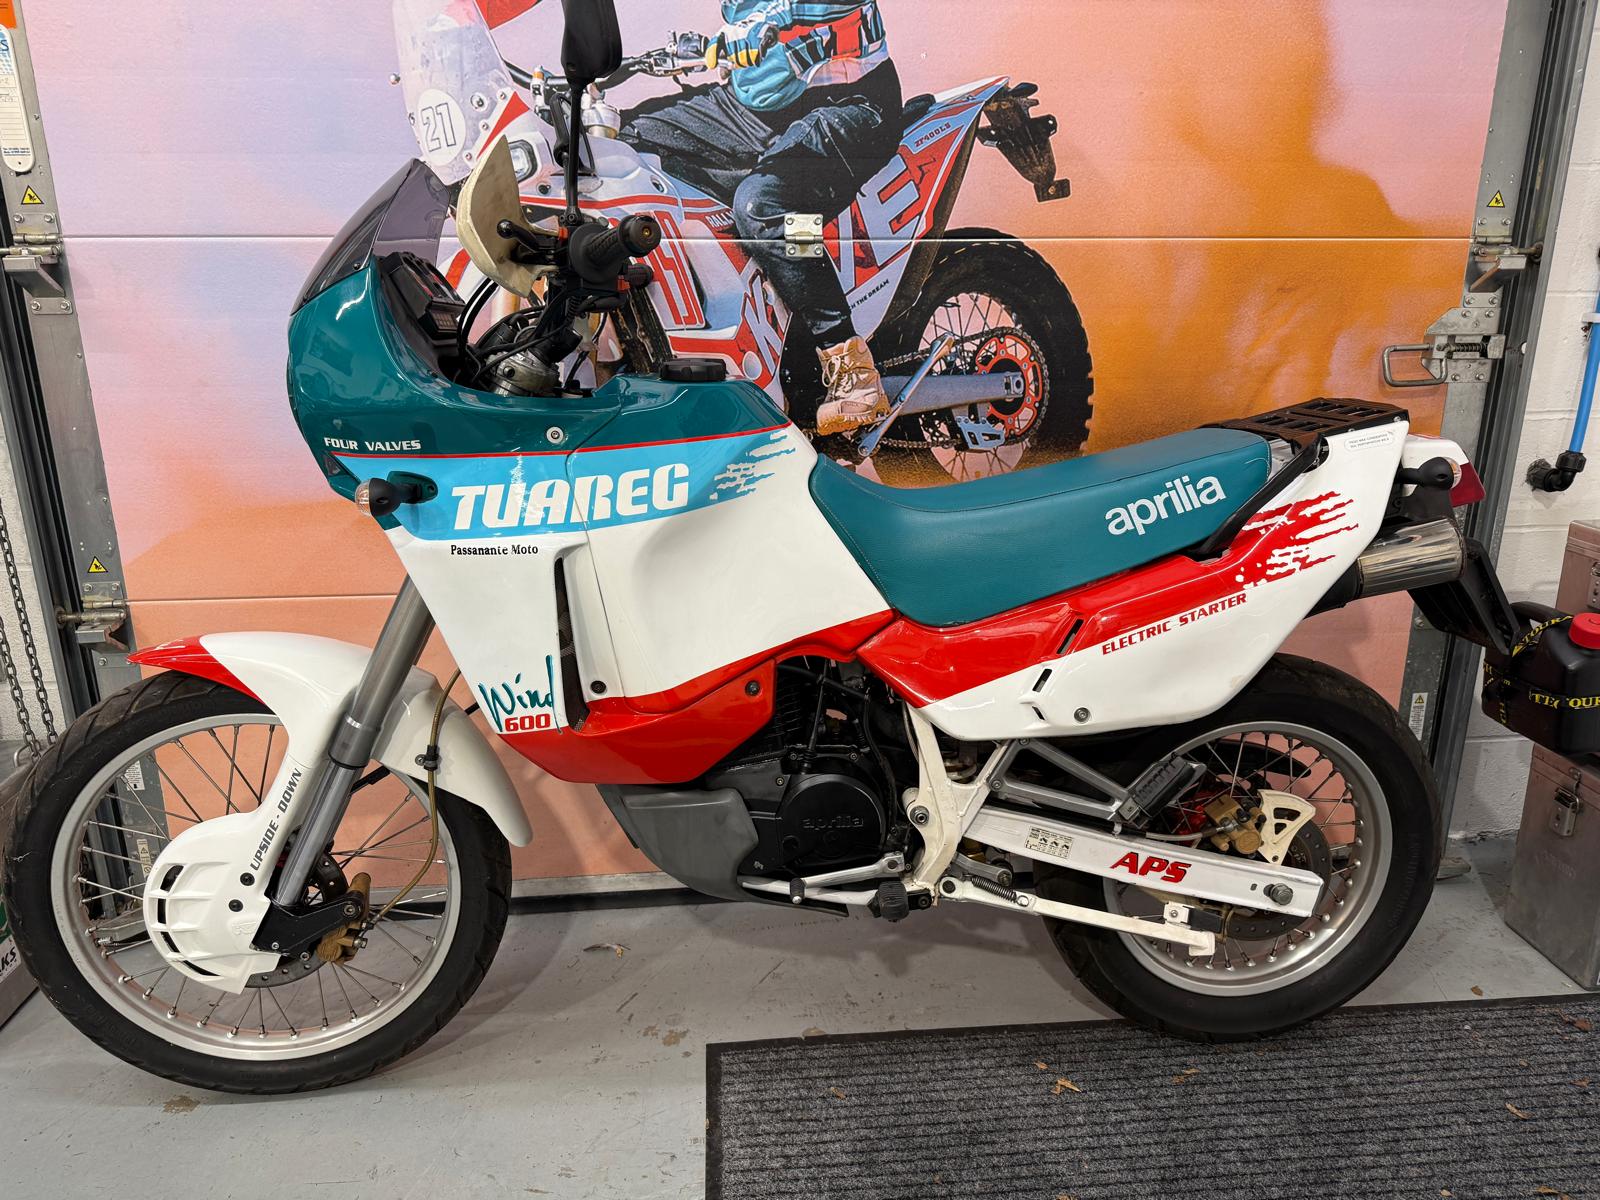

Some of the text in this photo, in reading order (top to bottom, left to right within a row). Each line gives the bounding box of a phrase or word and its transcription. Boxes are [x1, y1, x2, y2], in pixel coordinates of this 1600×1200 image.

[323, 437, 421, 451] FOUR VALVES
[452, 463, 690, 530] TUAREG
[1105, 475, 1227, 535] aprilia
[511, 544, 539, 555] Moto
[1102, 593, 1247, 655] ELECTRIC STARTER
[478, 655, 563, 733] Wind
[504, 713, 551, 732] 600
[250, 819, 279, 871] UPSIDE
[277, 768, 302, 813] DOWN
[1109, 851, 1192, 883] APS
